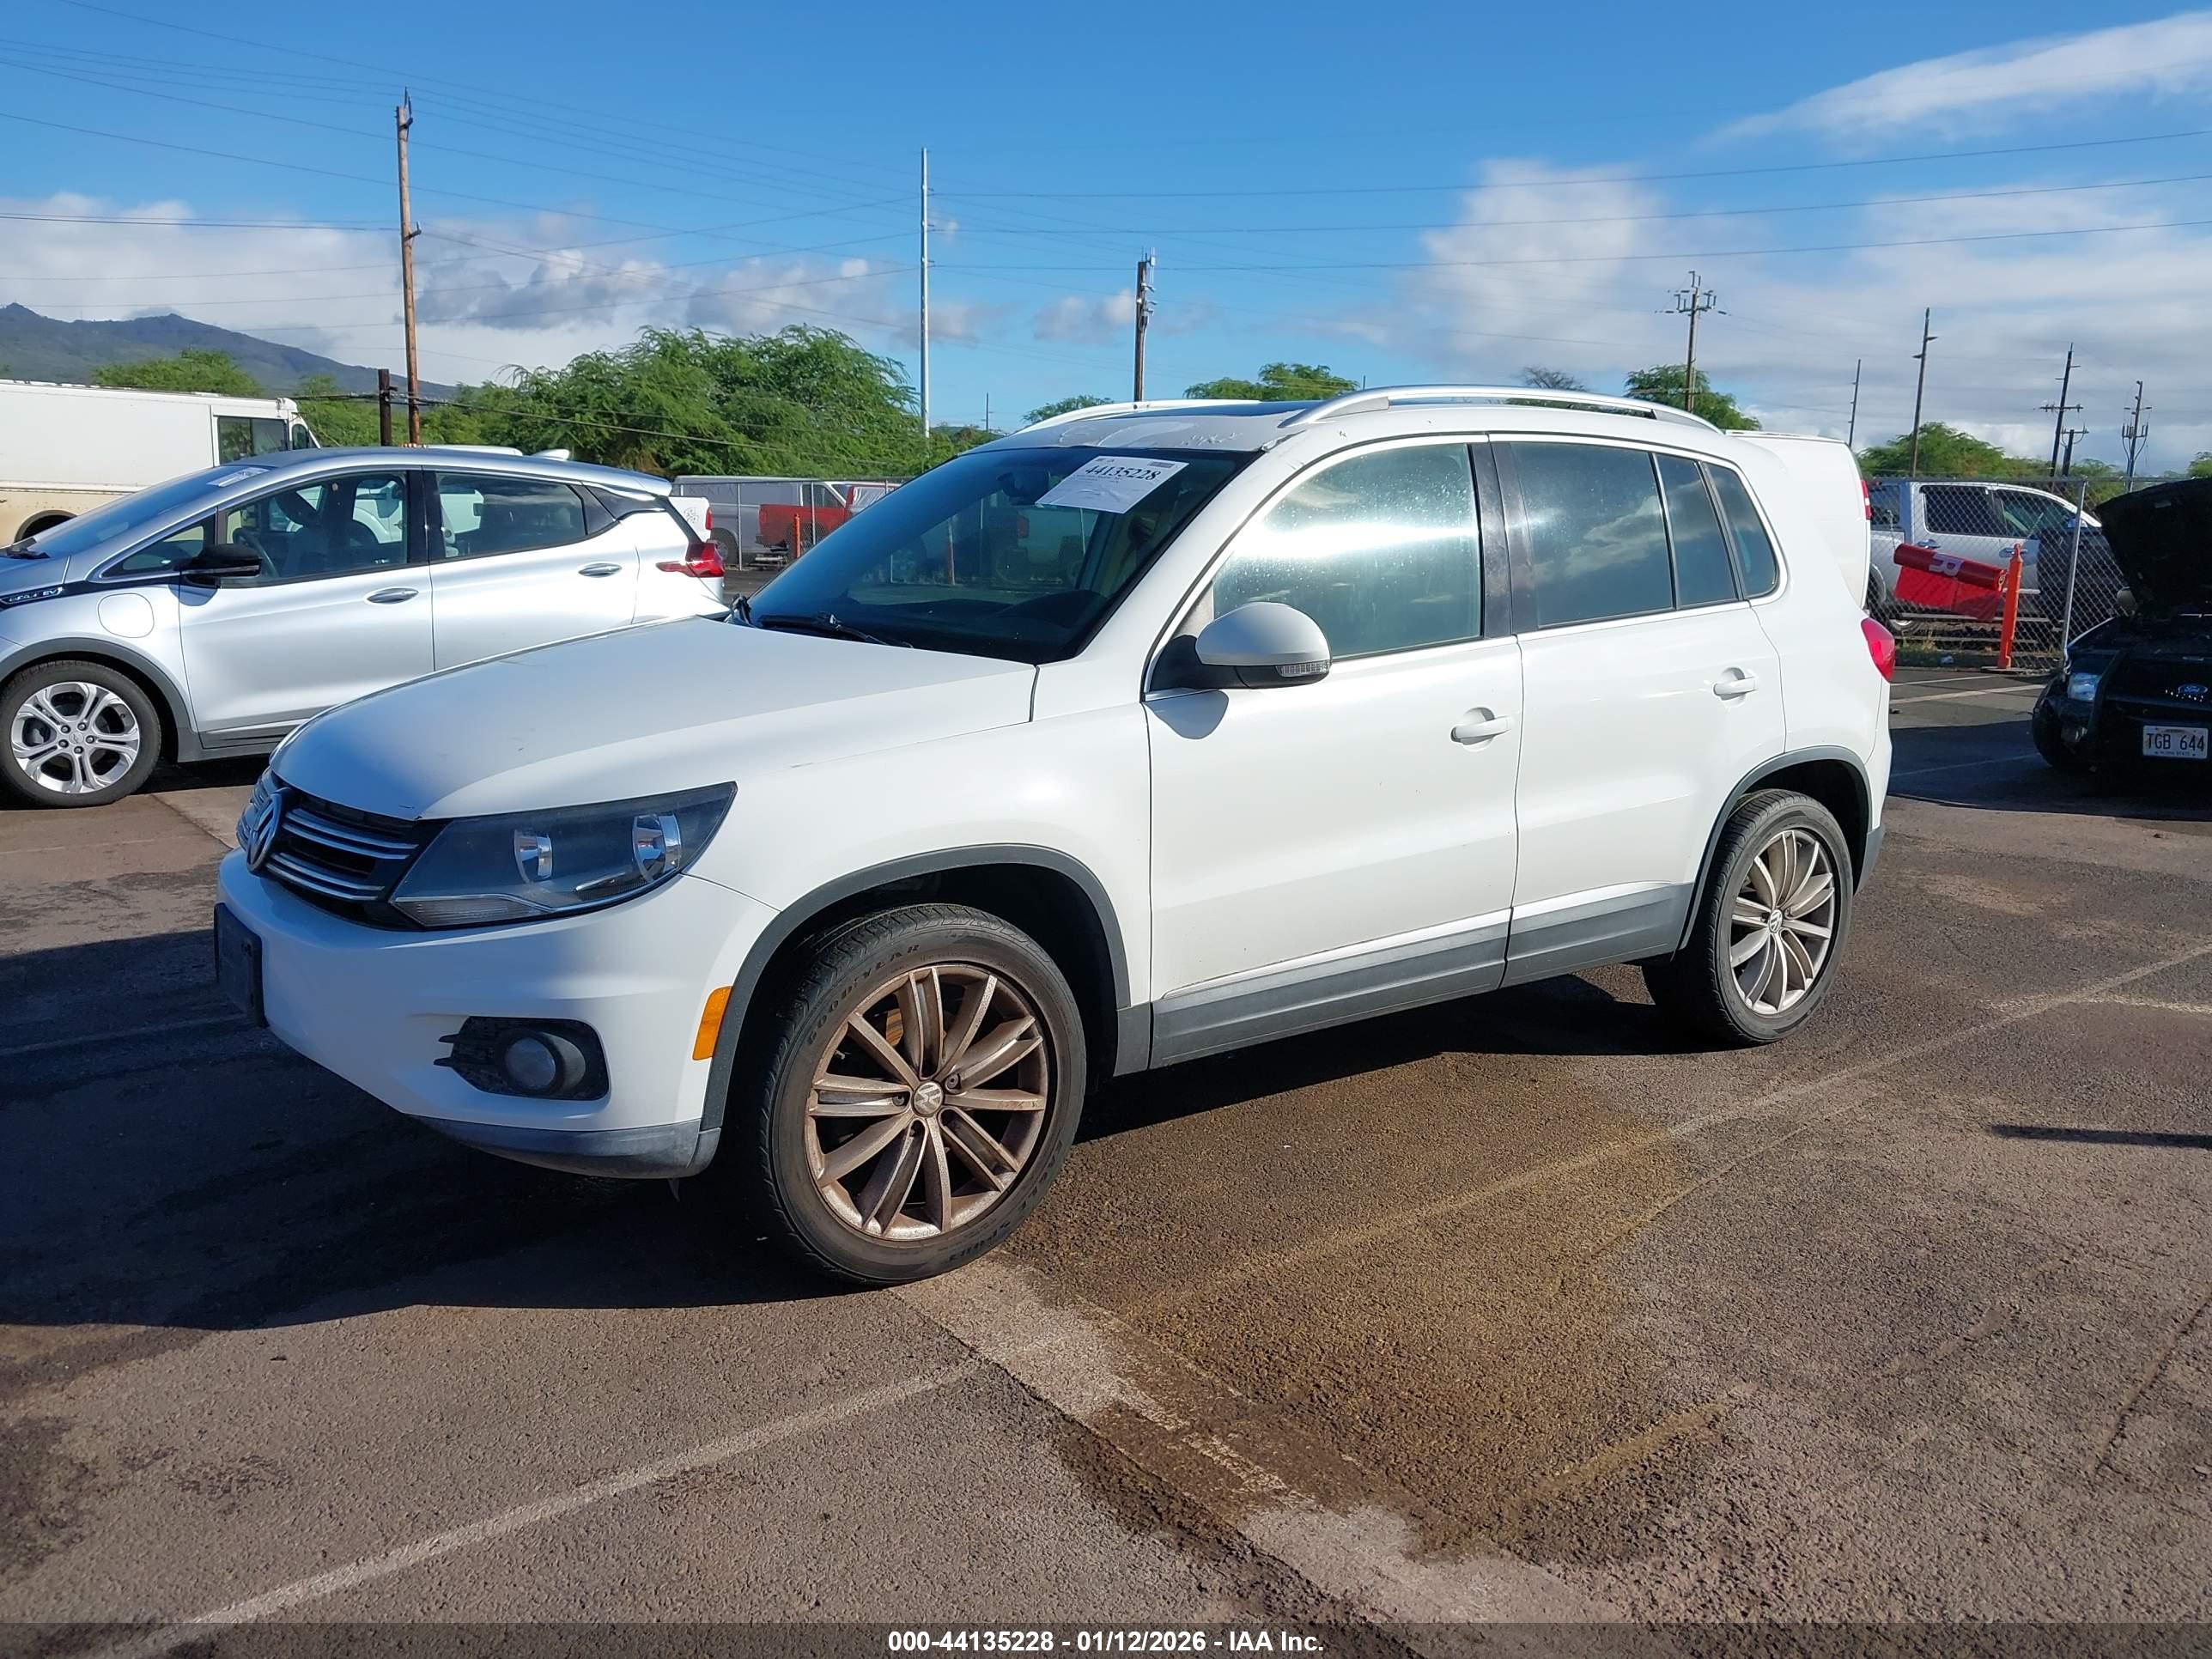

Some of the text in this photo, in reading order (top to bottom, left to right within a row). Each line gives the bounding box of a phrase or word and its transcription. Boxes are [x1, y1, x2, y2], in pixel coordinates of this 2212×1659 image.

[1085, 465, 1162, 481] 44135228
[2146, 732, 2204, 751] TGB 644
